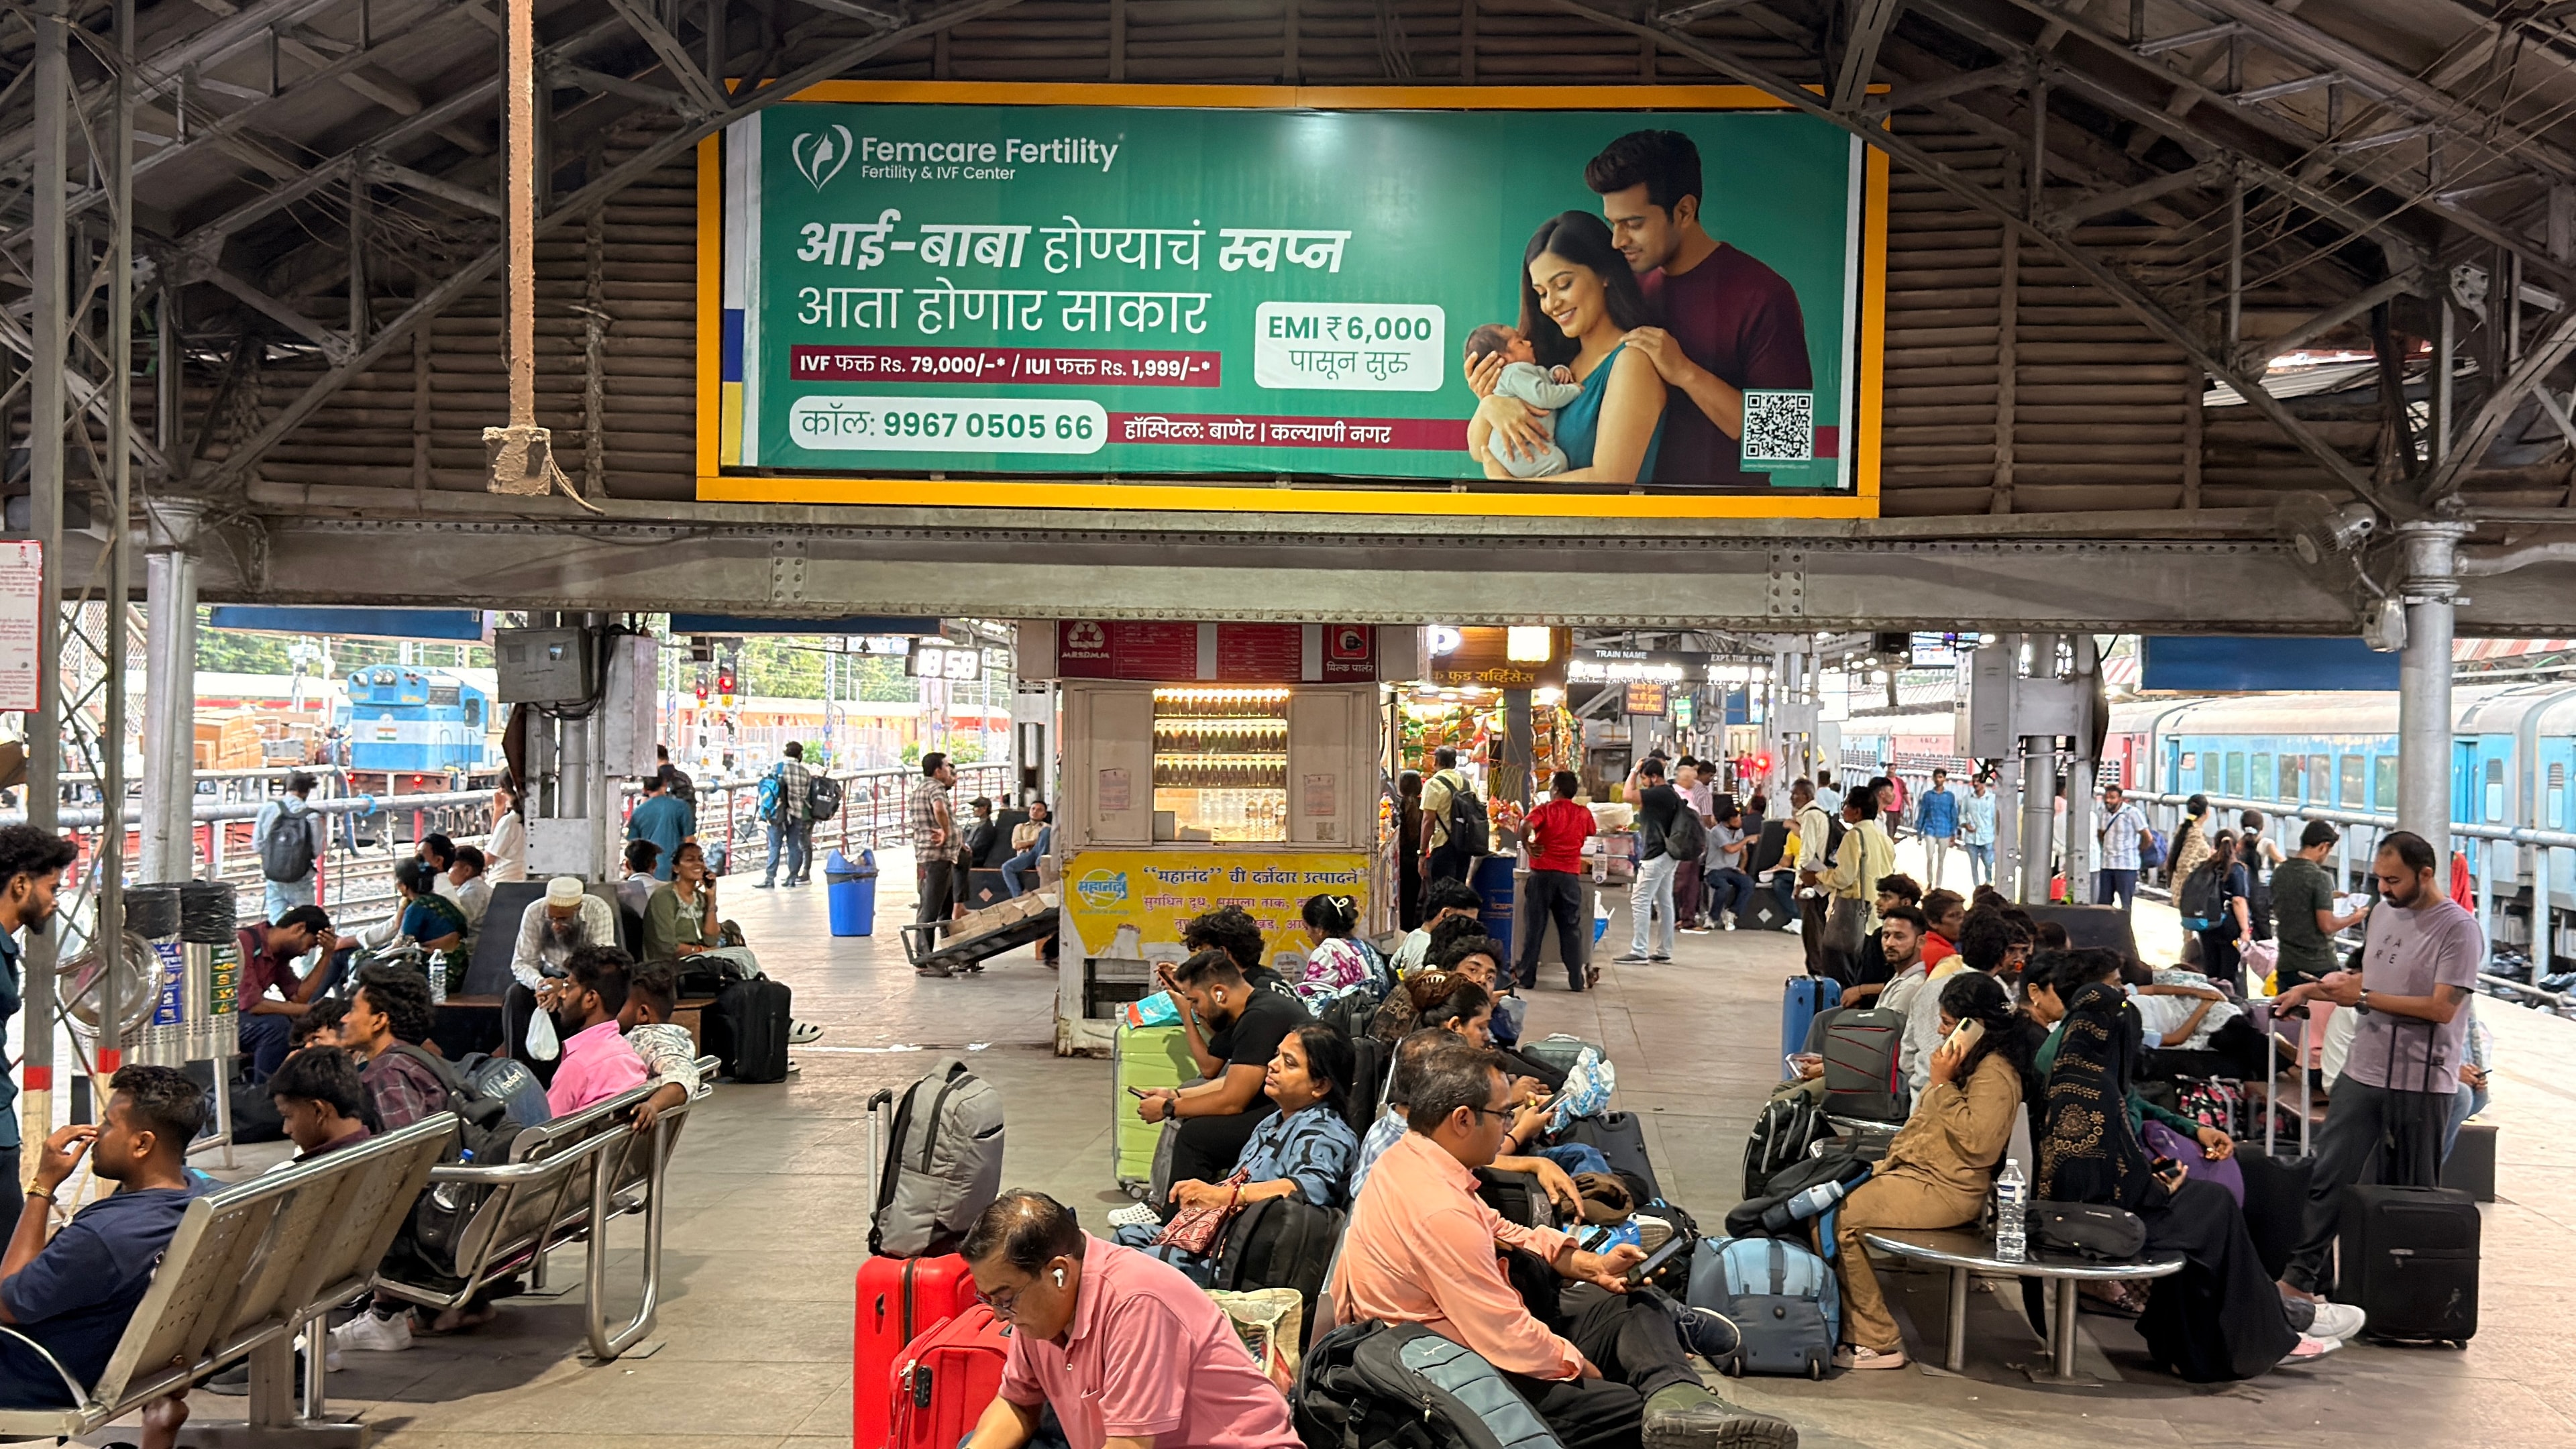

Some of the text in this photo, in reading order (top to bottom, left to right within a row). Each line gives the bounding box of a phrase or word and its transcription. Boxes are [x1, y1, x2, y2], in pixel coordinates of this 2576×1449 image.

[862, 137, 1118, 172] Femcare Fertility
[862, 165, 1016, 182] Fertility & IVF Center
[797, 209, 1352, 273] आई-बाबा होण्याचं स्वप्न
[798, 276, 1212, 334] आता होणार साकार
[1269, 316, 1318, 339] EMI
[800, 356, 830, 371] IVF
[835, 356, 876, 372] फक्त
[881, 357, 906, 372] Rs.
[1026, 358, 1051, 374] IUI
[1055, 358, 1097, 376] फक्त
[1101, 360, 1126, 376] Rs.
[1289, 350, 1358, 380] पासून
[800, 402, 1093, 439] कॉल: 9967 0505 66
[1124, 417, 1204, 439] हॉस्पिटल:
[1208, 419, 1256, 441] बाणेर
[1270, 421, 1346, 443] कल्याणी
[1349, 425, 1392, 443] नगर
[1595, 650, 1621, 658] TRAIN
[1327, 661, 1374, 672] मिल्क पार्लर
[1228, 867, 1246, 883] ची
[1252, 867, 1297, 884] दर्जेदार
[1303, 867, 1358, 884] उत्पादने
